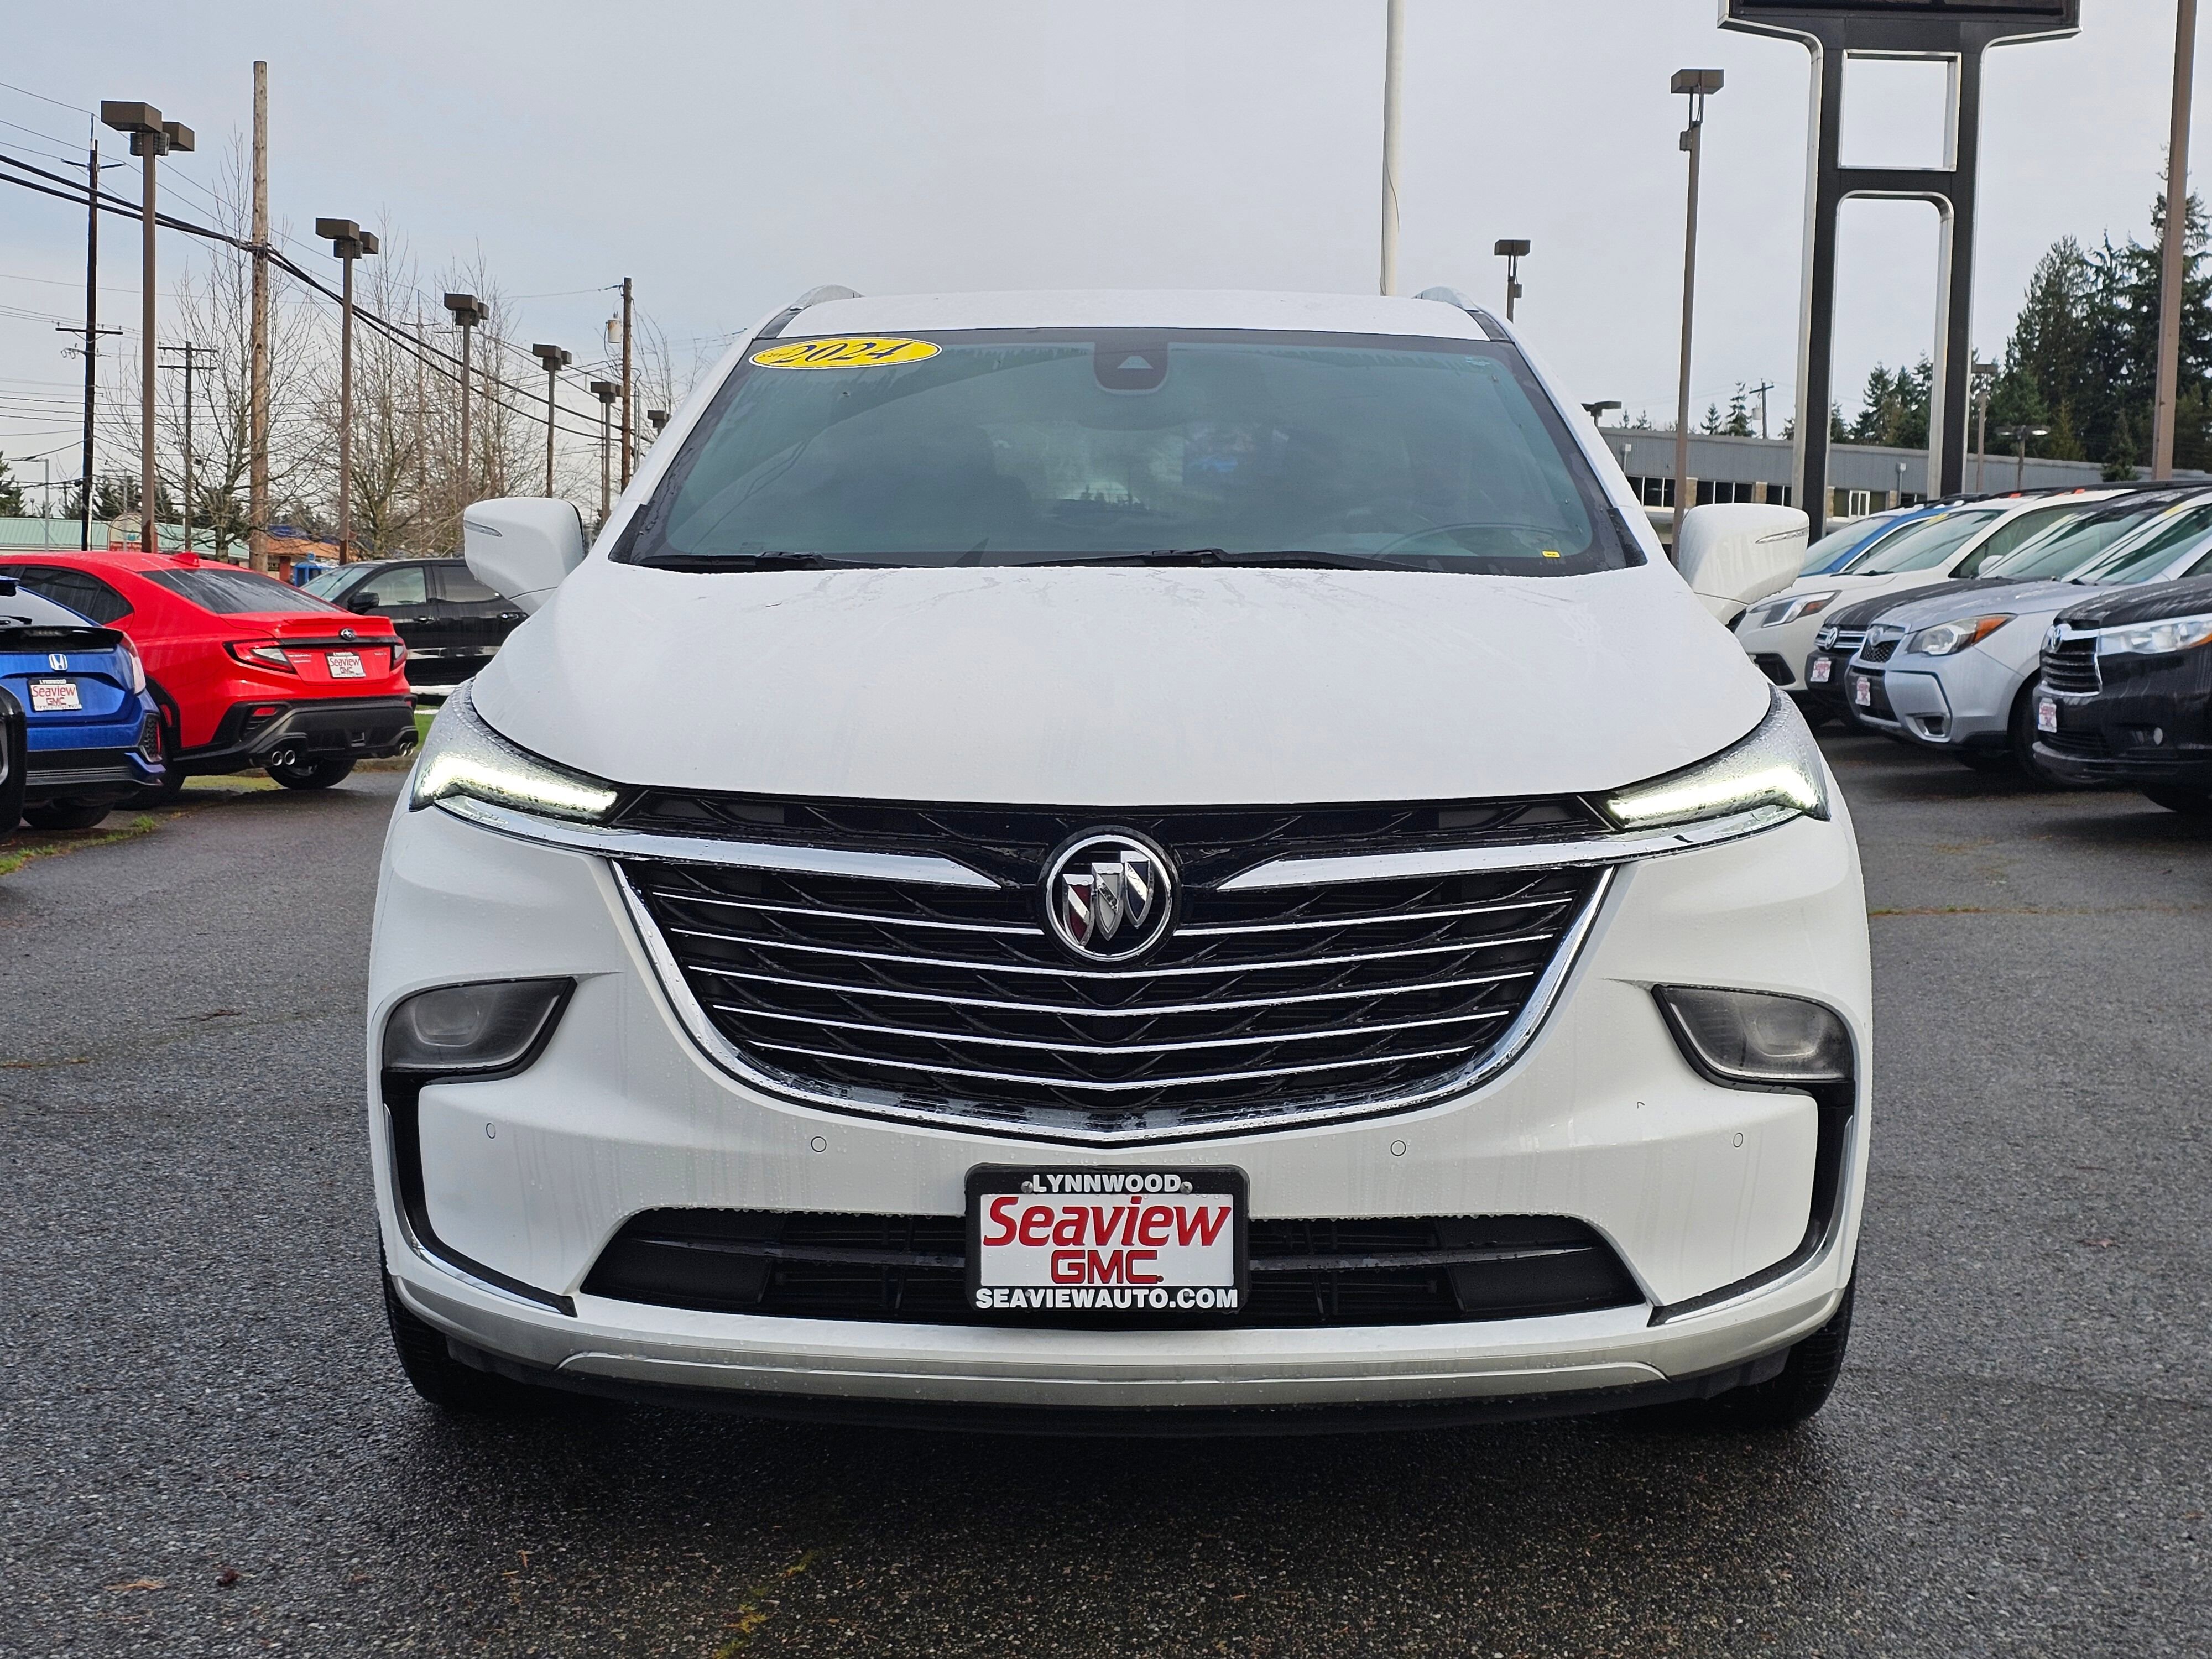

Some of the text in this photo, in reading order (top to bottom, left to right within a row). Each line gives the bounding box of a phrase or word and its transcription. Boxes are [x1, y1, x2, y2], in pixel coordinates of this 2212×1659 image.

[771, 342, 914, 364] 2024
[330, 656, 360, 666] Seaview
[33, 686, 75, 697] Seaview
[1033, 1174, 1181, 1193] LYNNWOOD
[983, 1196, 1232, 1246] Seaview
[1051, 1250, 1158, 1284] GMC
[977, 1288, 1238, 1308] SEAVIEWAUTO.COM
